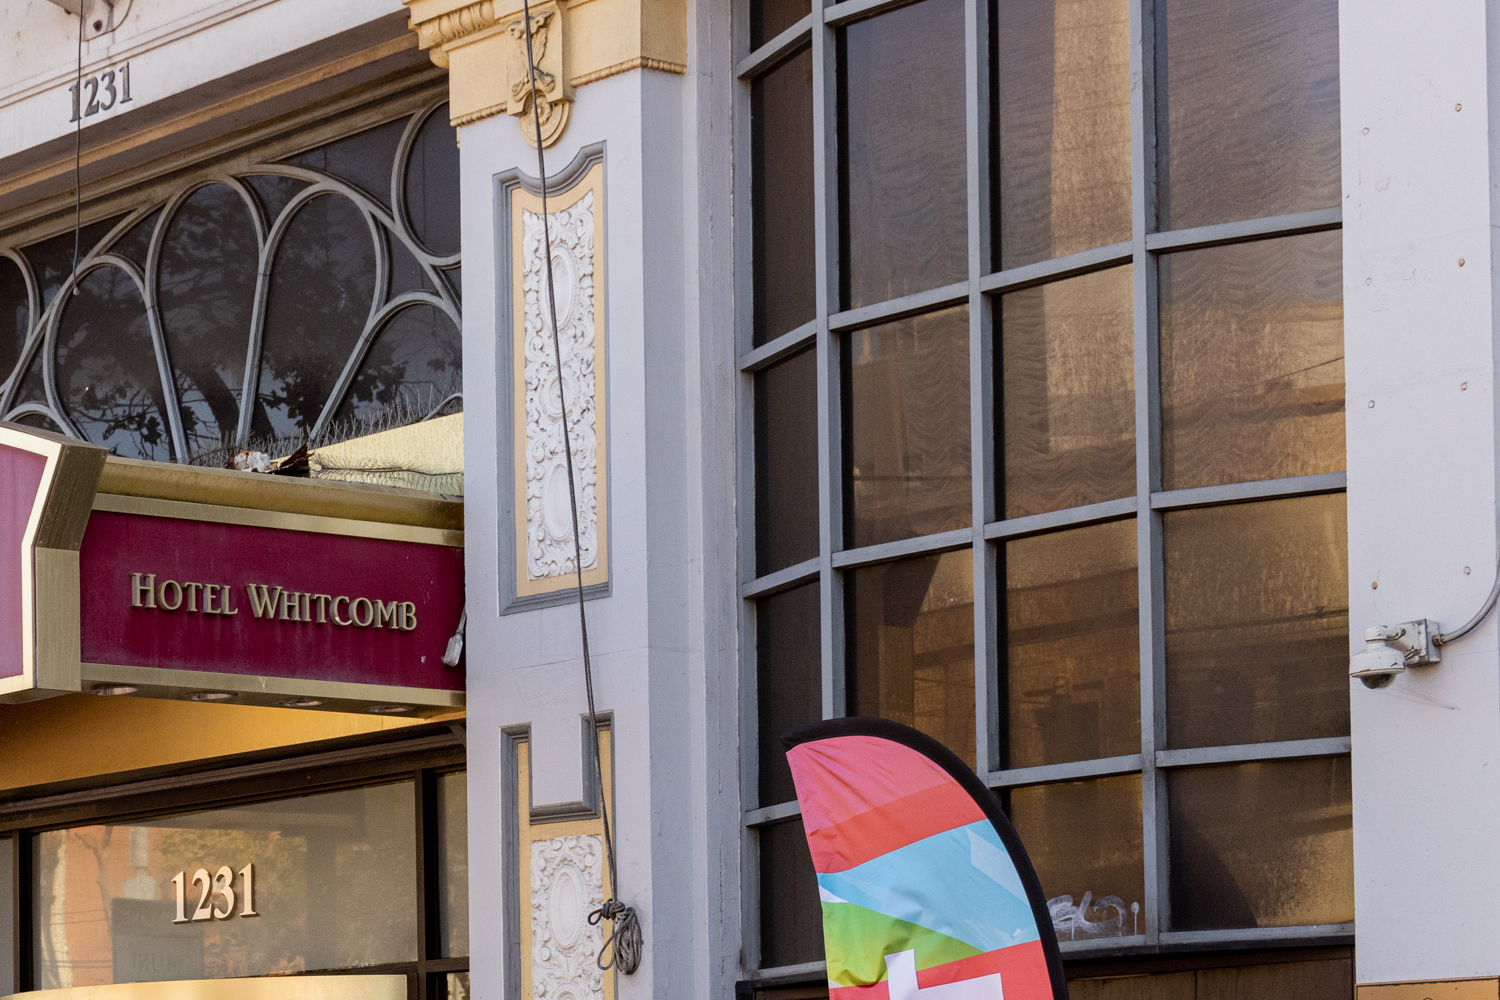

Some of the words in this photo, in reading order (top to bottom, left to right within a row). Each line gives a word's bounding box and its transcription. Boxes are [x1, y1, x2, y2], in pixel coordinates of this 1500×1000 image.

[68, 60, 133, 123] 1231
[130, 572, 239, 616] HOTEL
[246, 582, 418, 632] WHITCOMB
[170, 862, 260, 925] 1231
